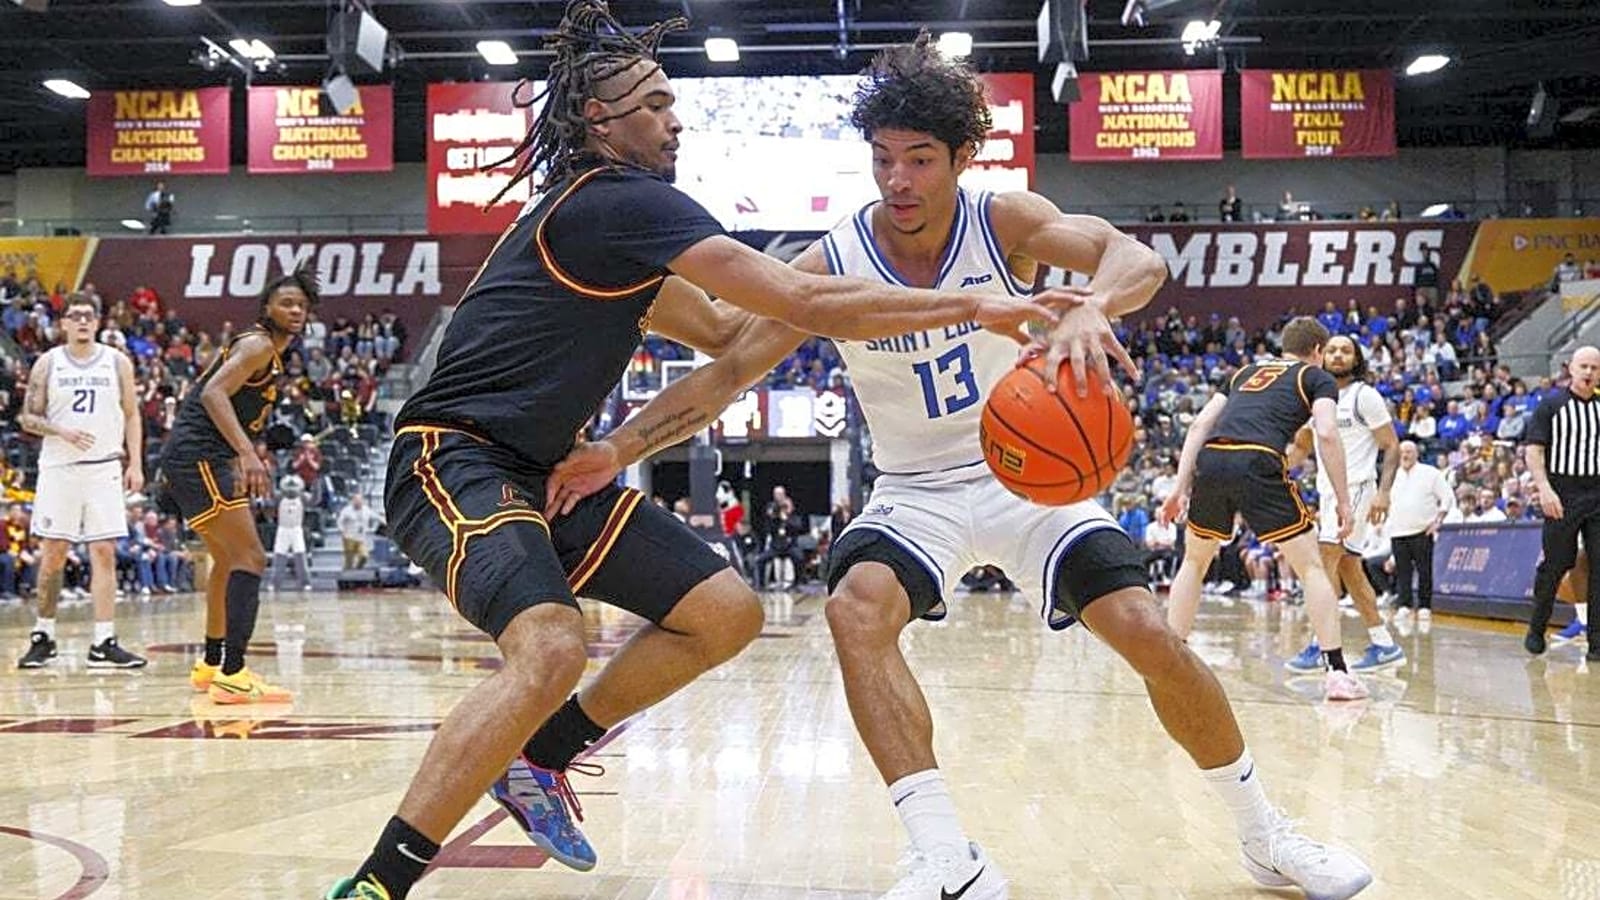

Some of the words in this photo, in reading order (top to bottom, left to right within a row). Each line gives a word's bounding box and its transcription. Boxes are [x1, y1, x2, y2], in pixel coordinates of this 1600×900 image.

[1099, 73, 1192, 103] NCAA
[1272, 73, 1364, 101] NCAA
[115, 92, 201, 119] NCAA
[1103, 114, 1189, 130] NATIONAL
[1293, 112, 1344, 127] FINAL
[118, 130, 199, 145] NATIONAL
[279, 126, 362, 142] NATIONAL
[1096, 131, 1196, 148] CHAMPIONS
[1296, 130, 1341, 145] FOUR
[111, 147, 205, 162] CHAMPIONS
[273, 144, 367, 160] CHAMPIONS
[184, 242, 442, 297] LOYOLA
[911, 342, 980, 419] 13
[1238, 366, 1289, 392] 5
[72, 389, 96, 414] 21
